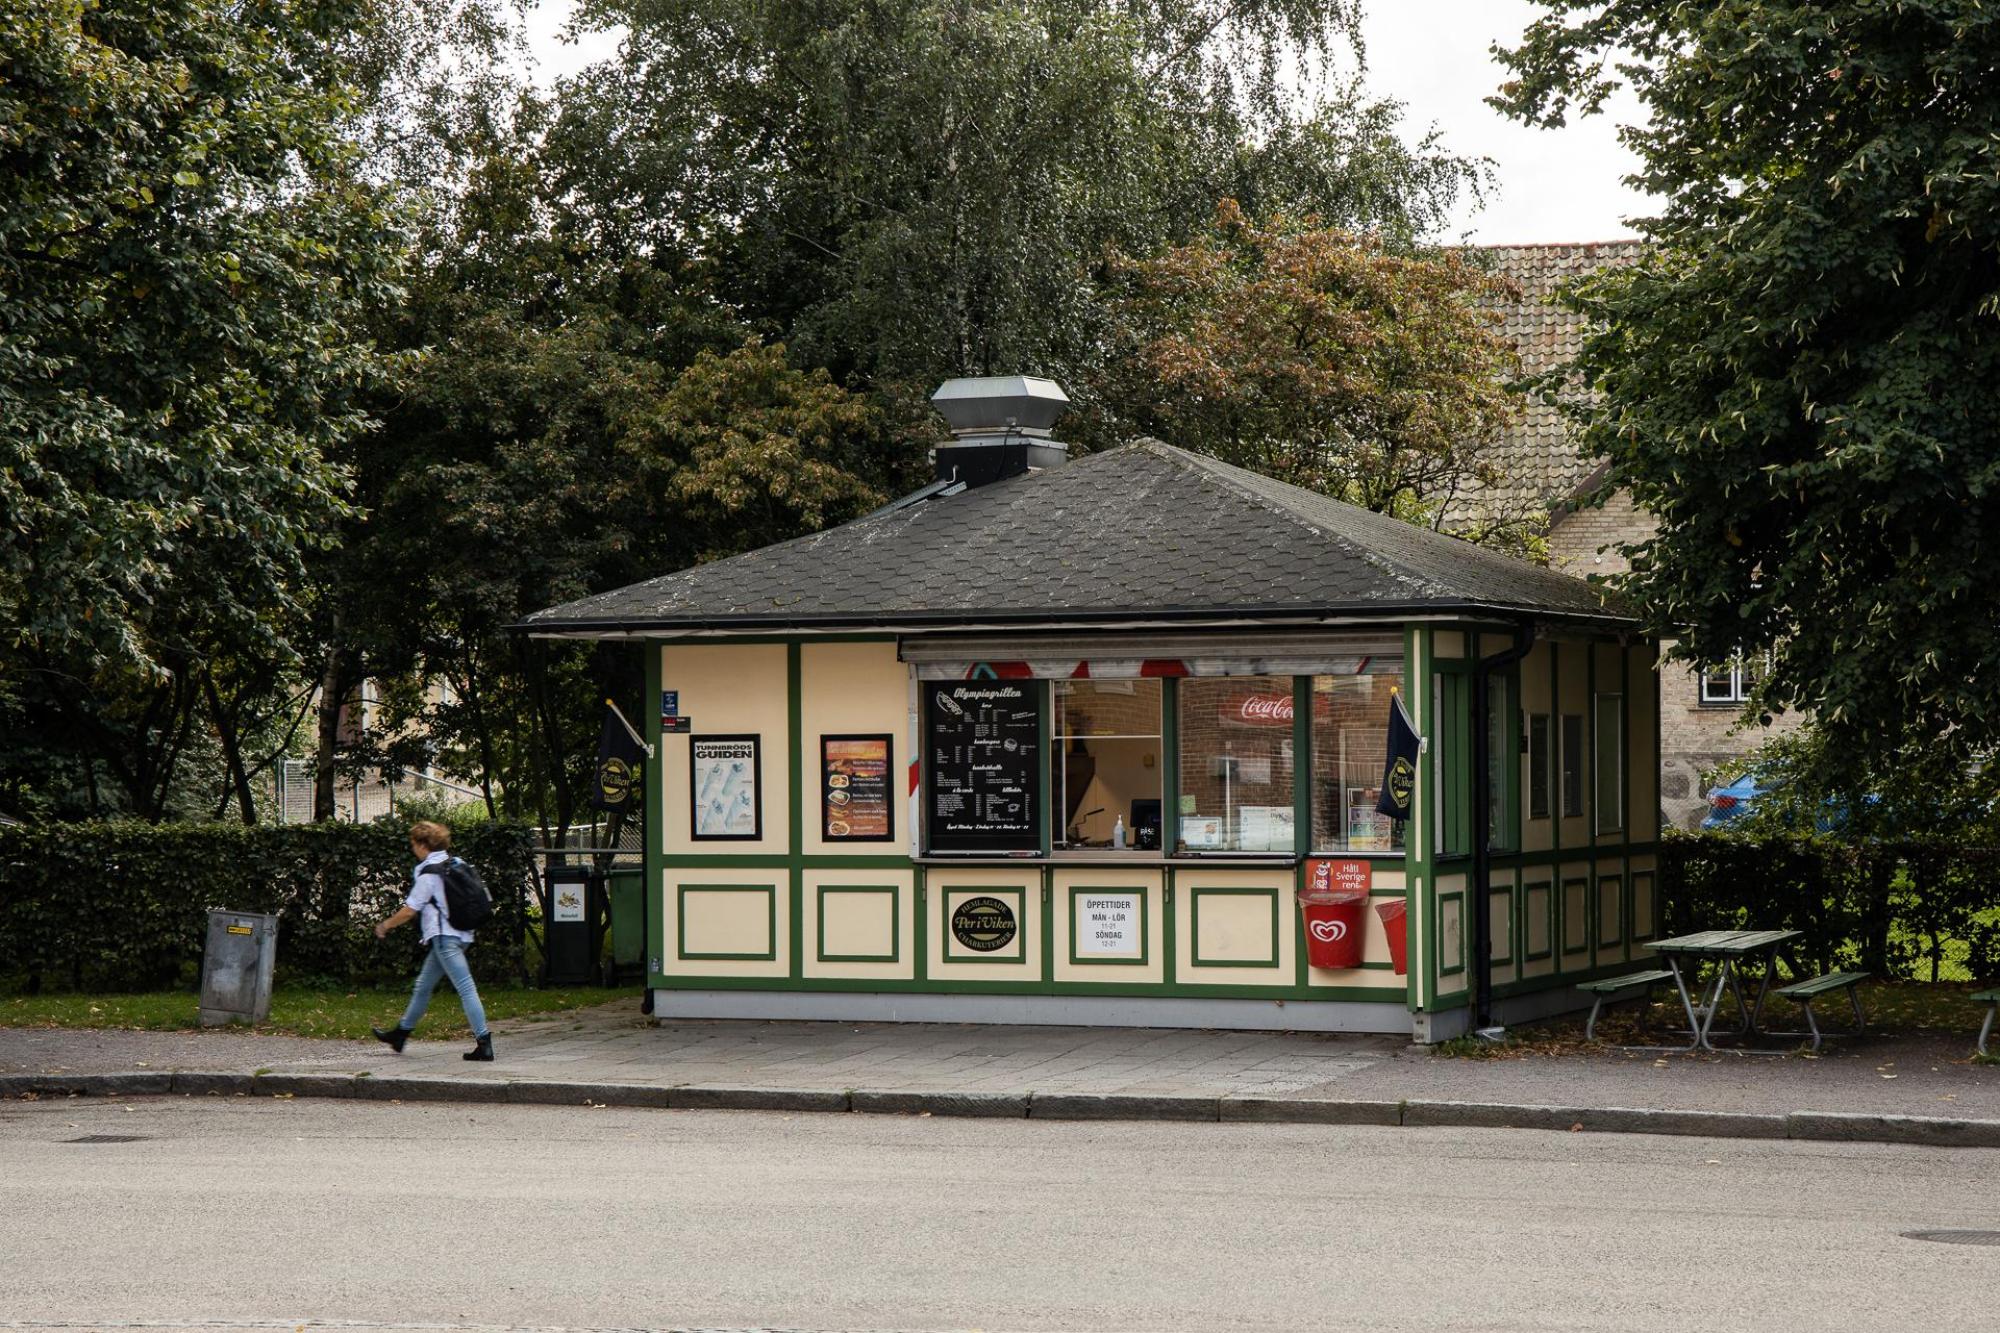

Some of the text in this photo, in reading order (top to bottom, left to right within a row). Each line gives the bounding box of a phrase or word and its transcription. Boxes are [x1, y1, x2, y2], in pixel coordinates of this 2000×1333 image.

[953, 687, 1023, 700] Olympiagrillen
[1241, 696, 1294, 719] Coca-Co
[695, 750, 752, 759] GUIDEN
[1343, 863, 1359, 873] Håll
[1336, 872, 1366, 882] Sverige
[1087, 899, 1131, 909] ÖPPETTIDER
[1092, 912, 1107, 921] MÅN
[1112, 912, 1126, 921] LÖR
[955, 916, 976, 929] Per
[981, 916, 1015, 929] Viken
[1095, 930, 1122, 939] SÖNDAG
